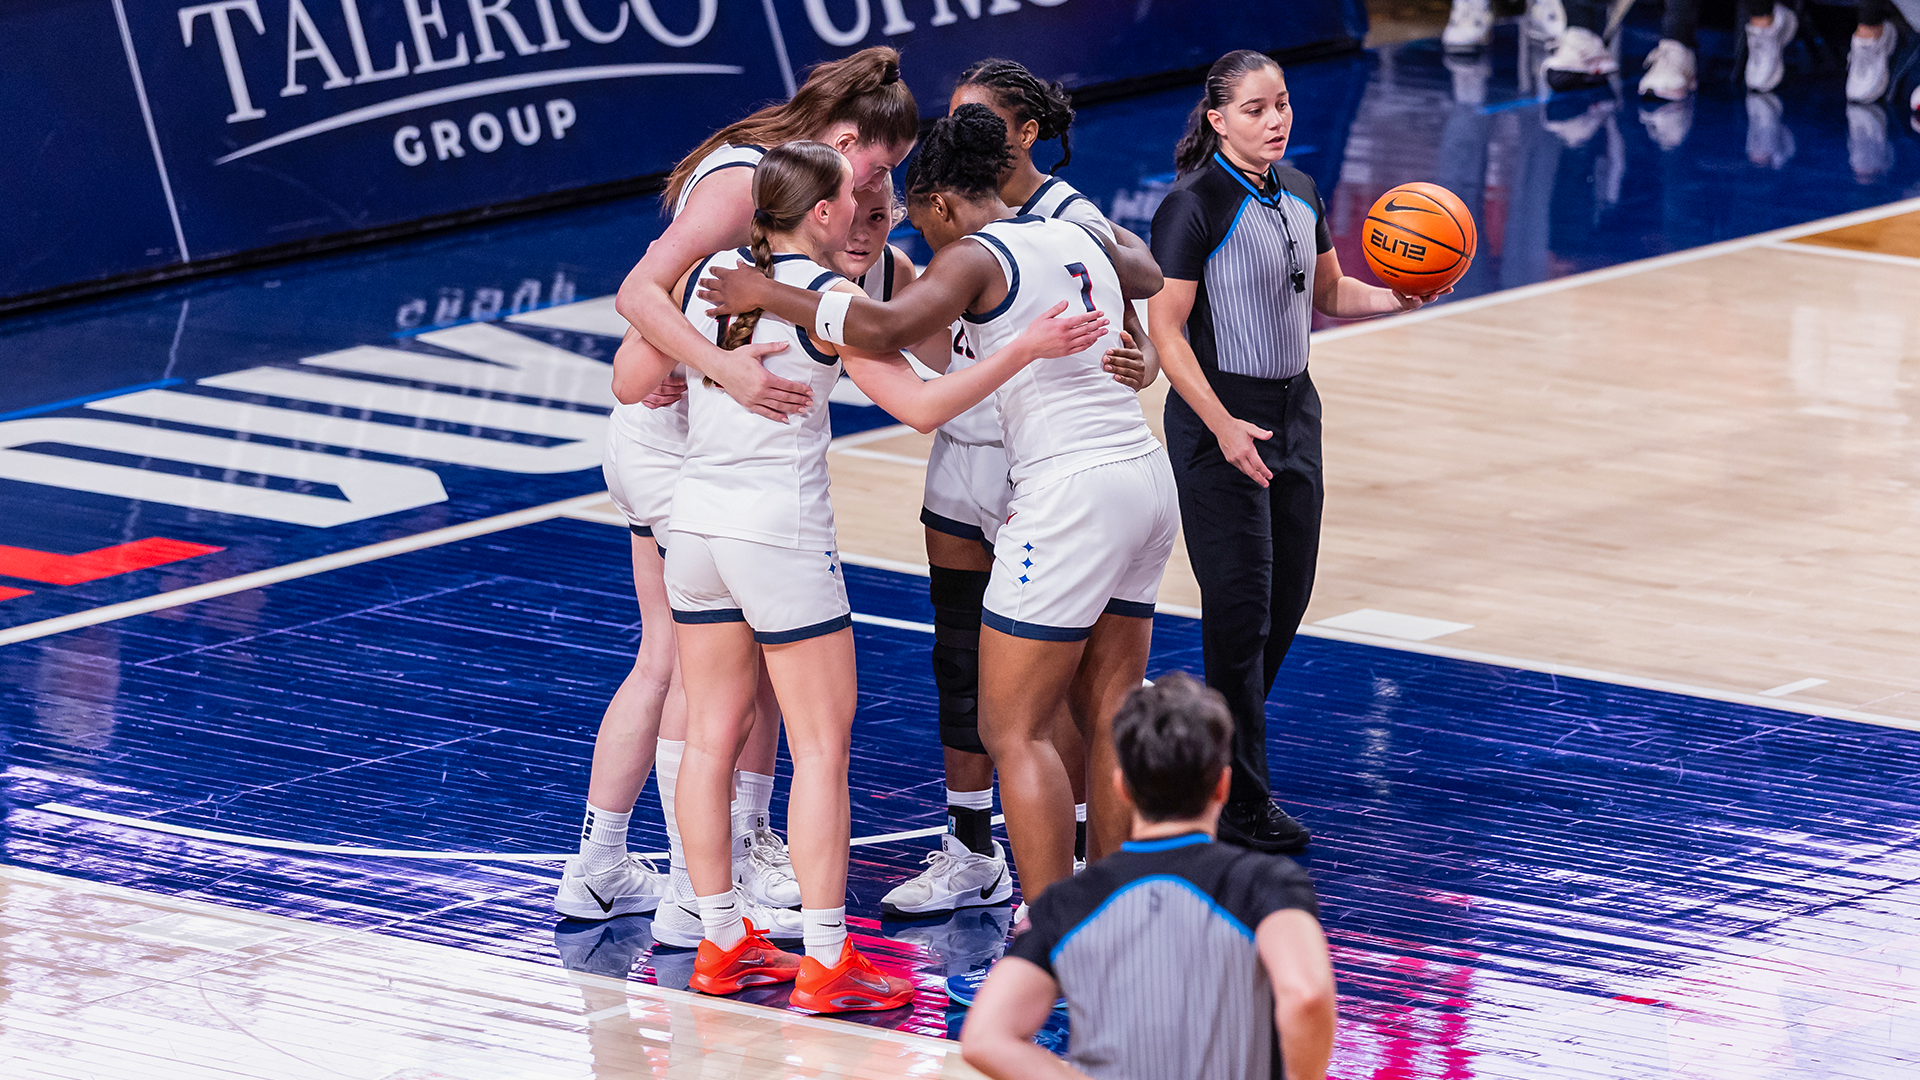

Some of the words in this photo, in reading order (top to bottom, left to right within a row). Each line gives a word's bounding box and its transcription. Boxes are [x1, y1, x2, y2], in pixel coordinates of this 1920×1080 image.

[393, 98, 577, 167] GROUP
[1370, 228, 1427, 262] ELITE
[1064, 262, 1098, 332] 7
